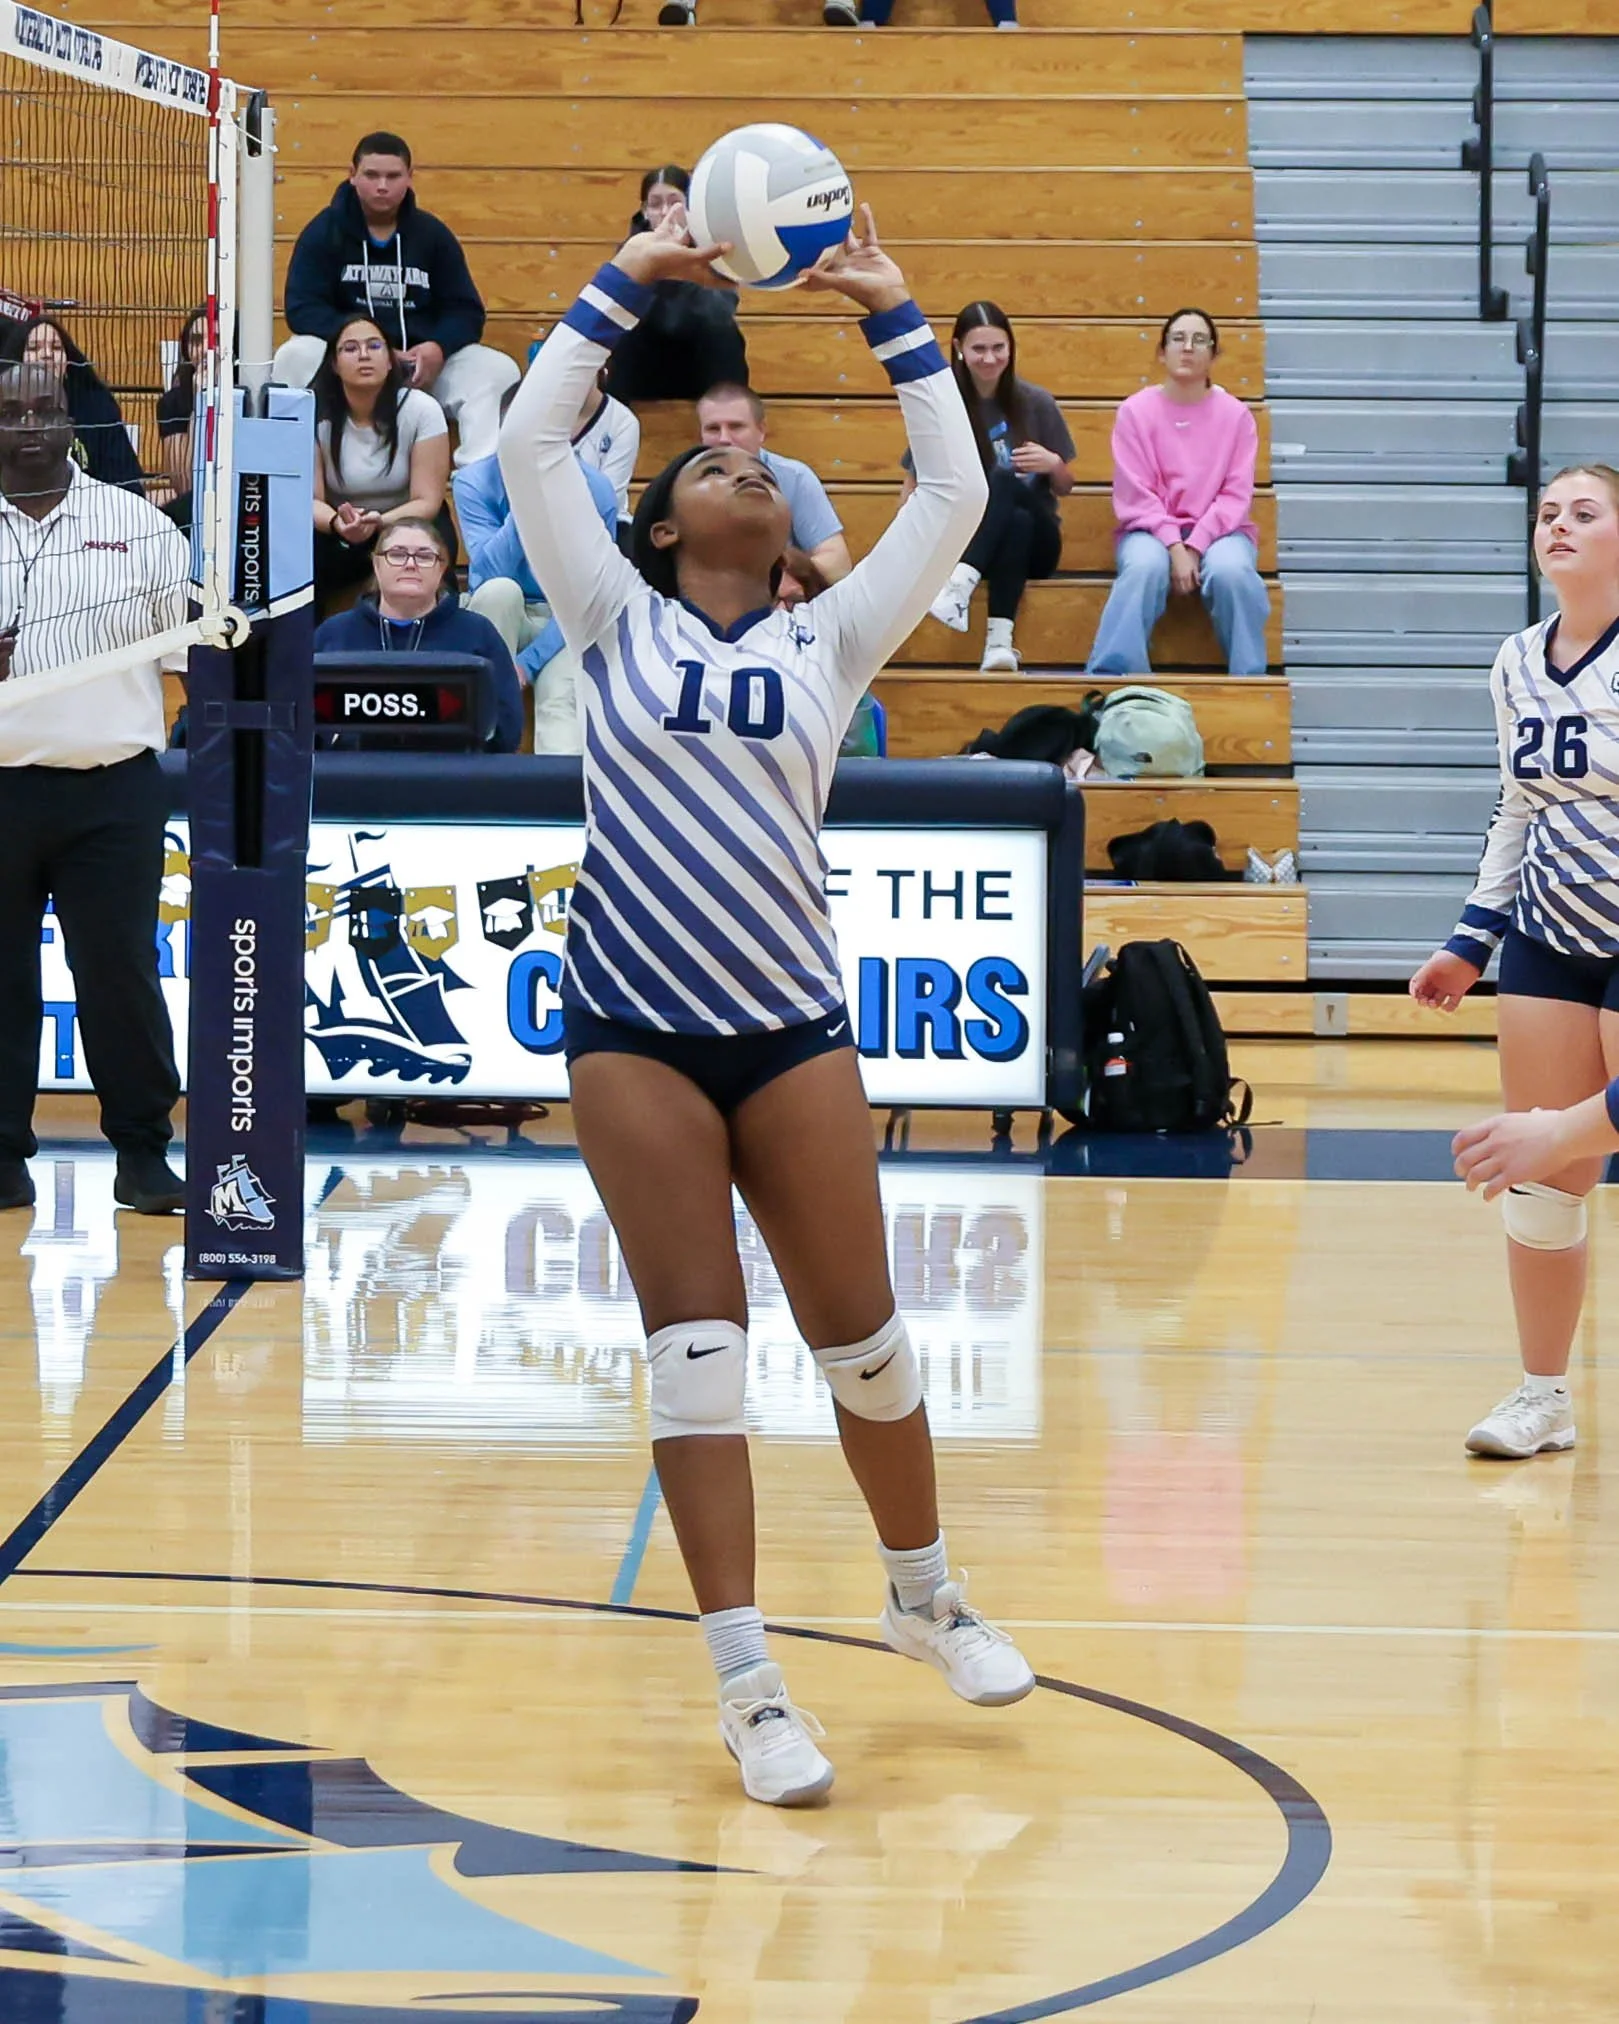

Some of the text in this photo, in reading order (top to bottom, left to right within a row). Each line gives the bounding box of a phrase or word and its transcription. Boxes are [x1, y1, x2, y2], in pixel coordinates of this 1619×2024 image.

[344, 693, 426, 717] POSS.
[663, 659, 785, 741] 10
[1512, 715, 1589, 780] 26
[876, 869, 1013, 921] THE
[227, 918, 259, 1132] sports imports
[199, 1252, 277, 1265] (800) 556-3198
